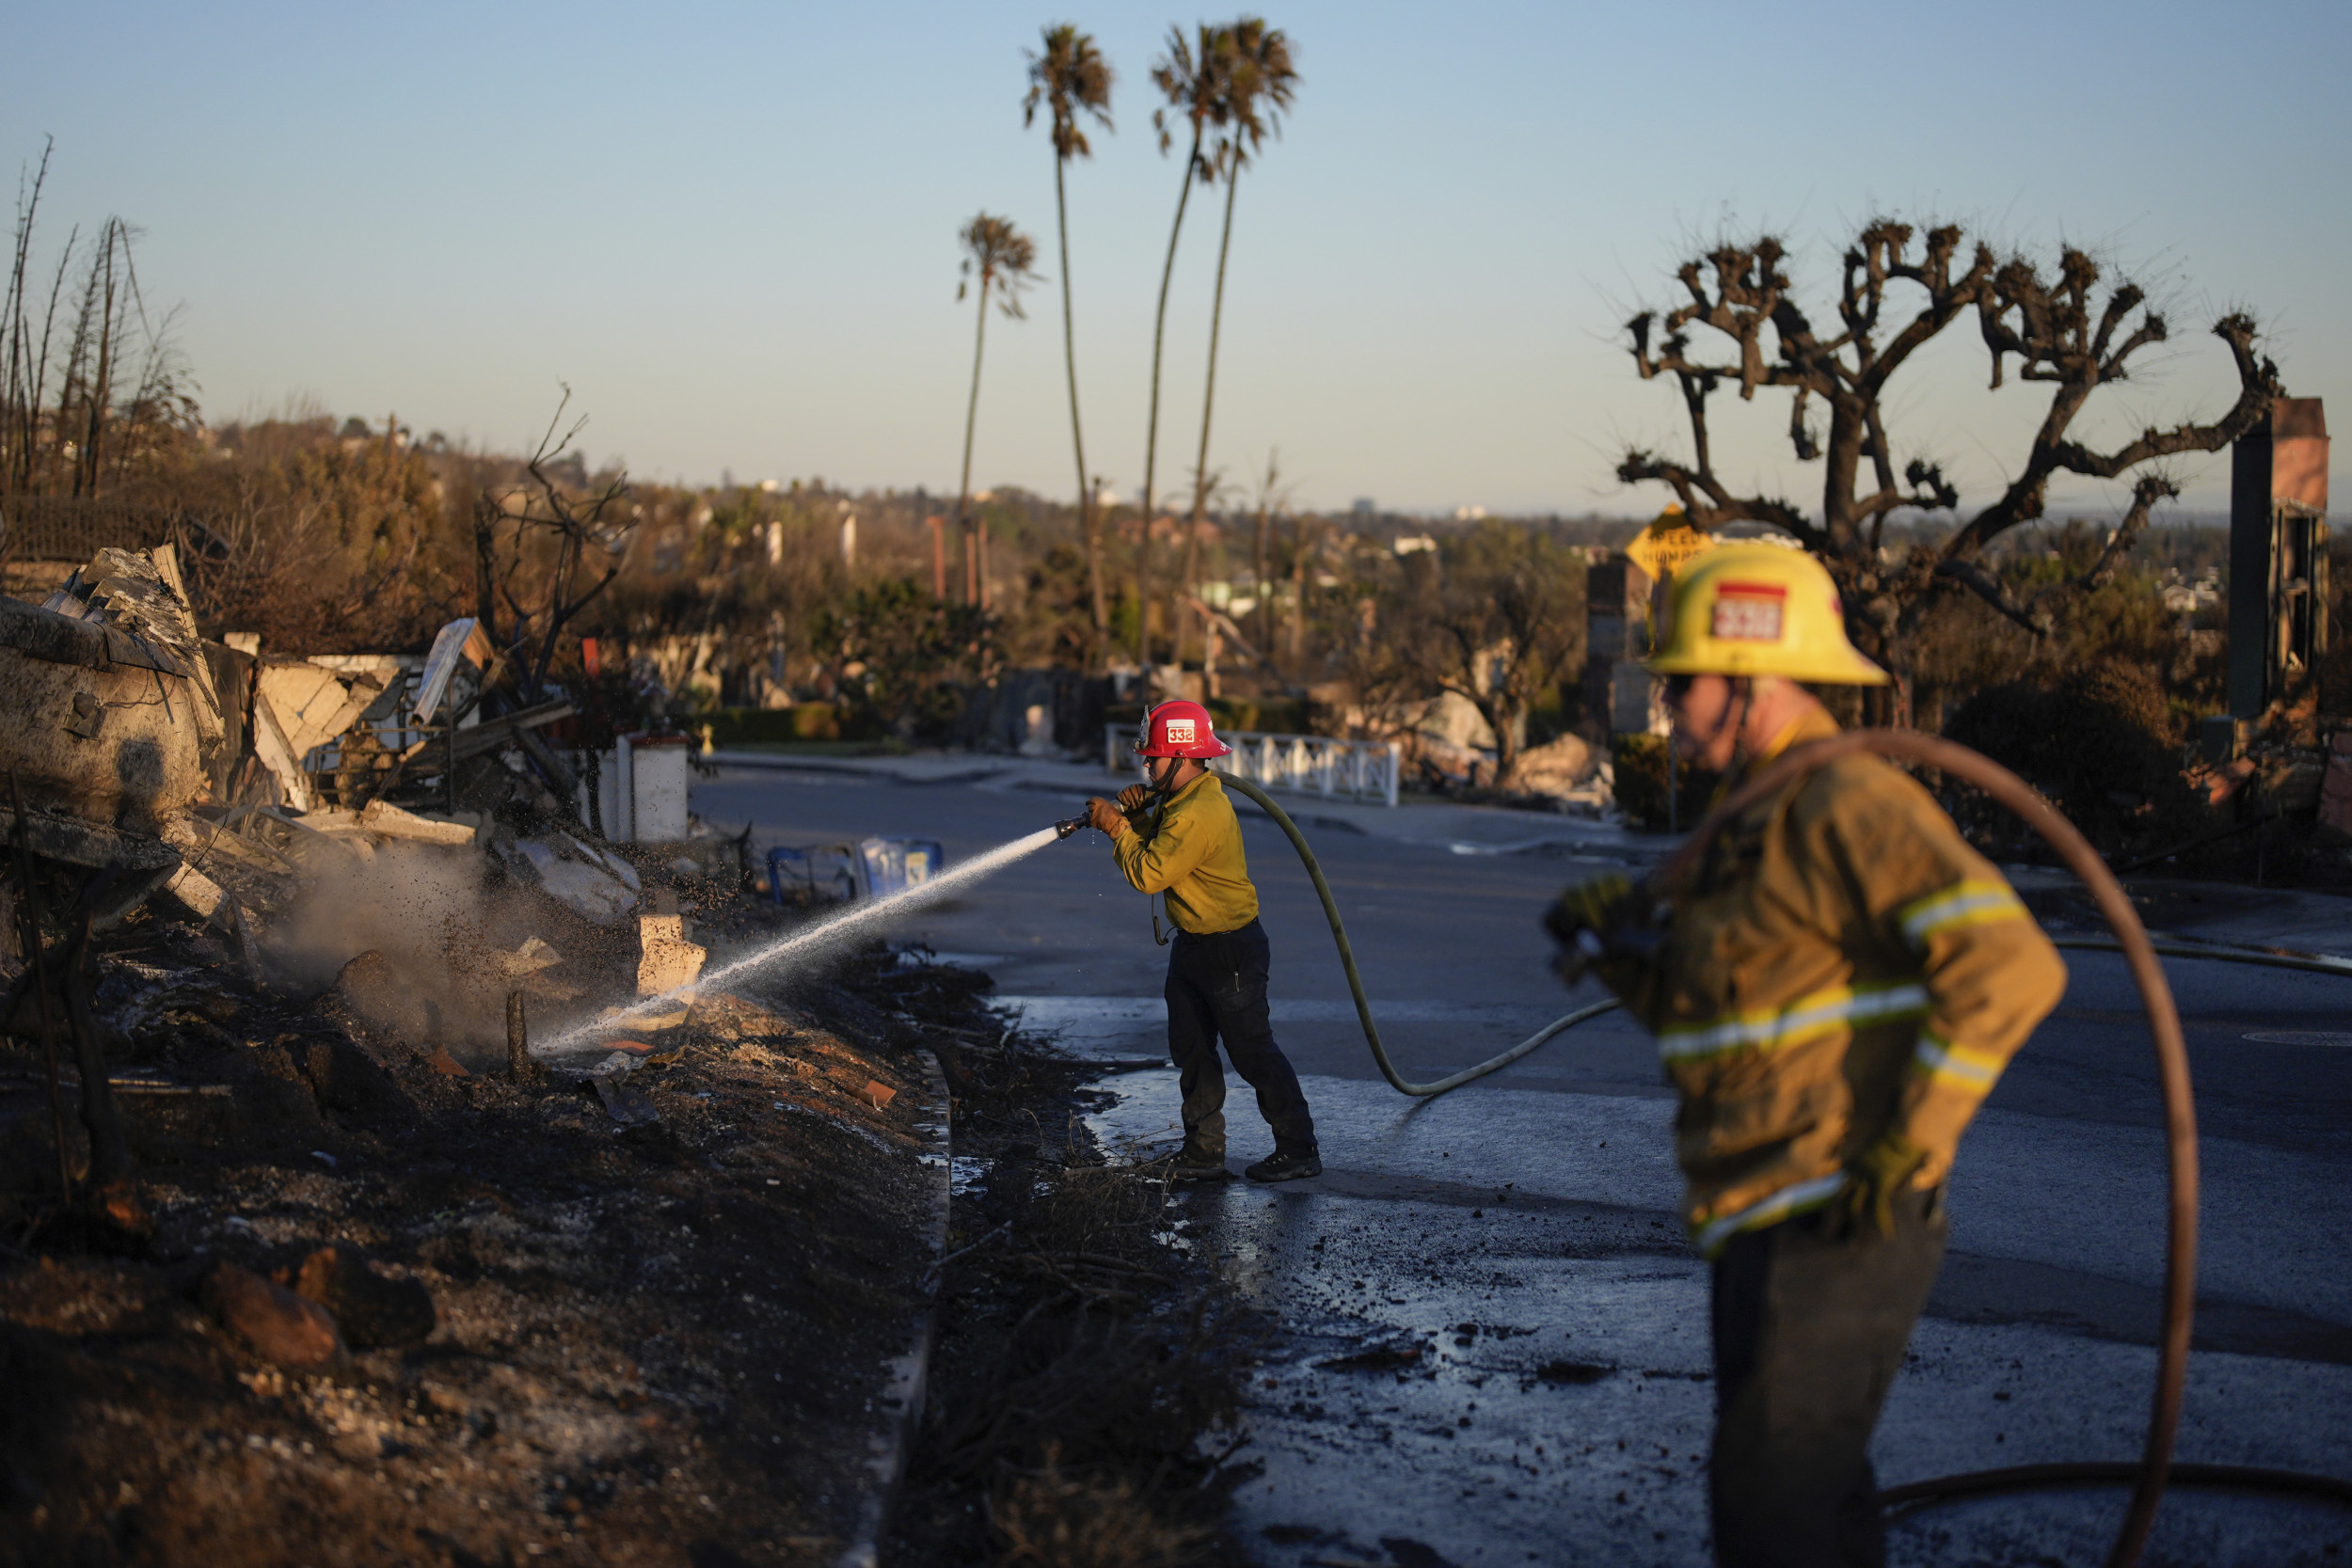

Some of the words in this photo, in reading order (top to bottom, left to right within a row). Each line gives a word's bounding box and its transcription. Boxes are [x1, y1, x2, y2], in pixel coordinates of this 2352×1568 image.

[1647, 531, 1701, 545] SPEED
[1643, 549, 1702, 562] HUMPS
[1169, 729, 1193, 741] 332
